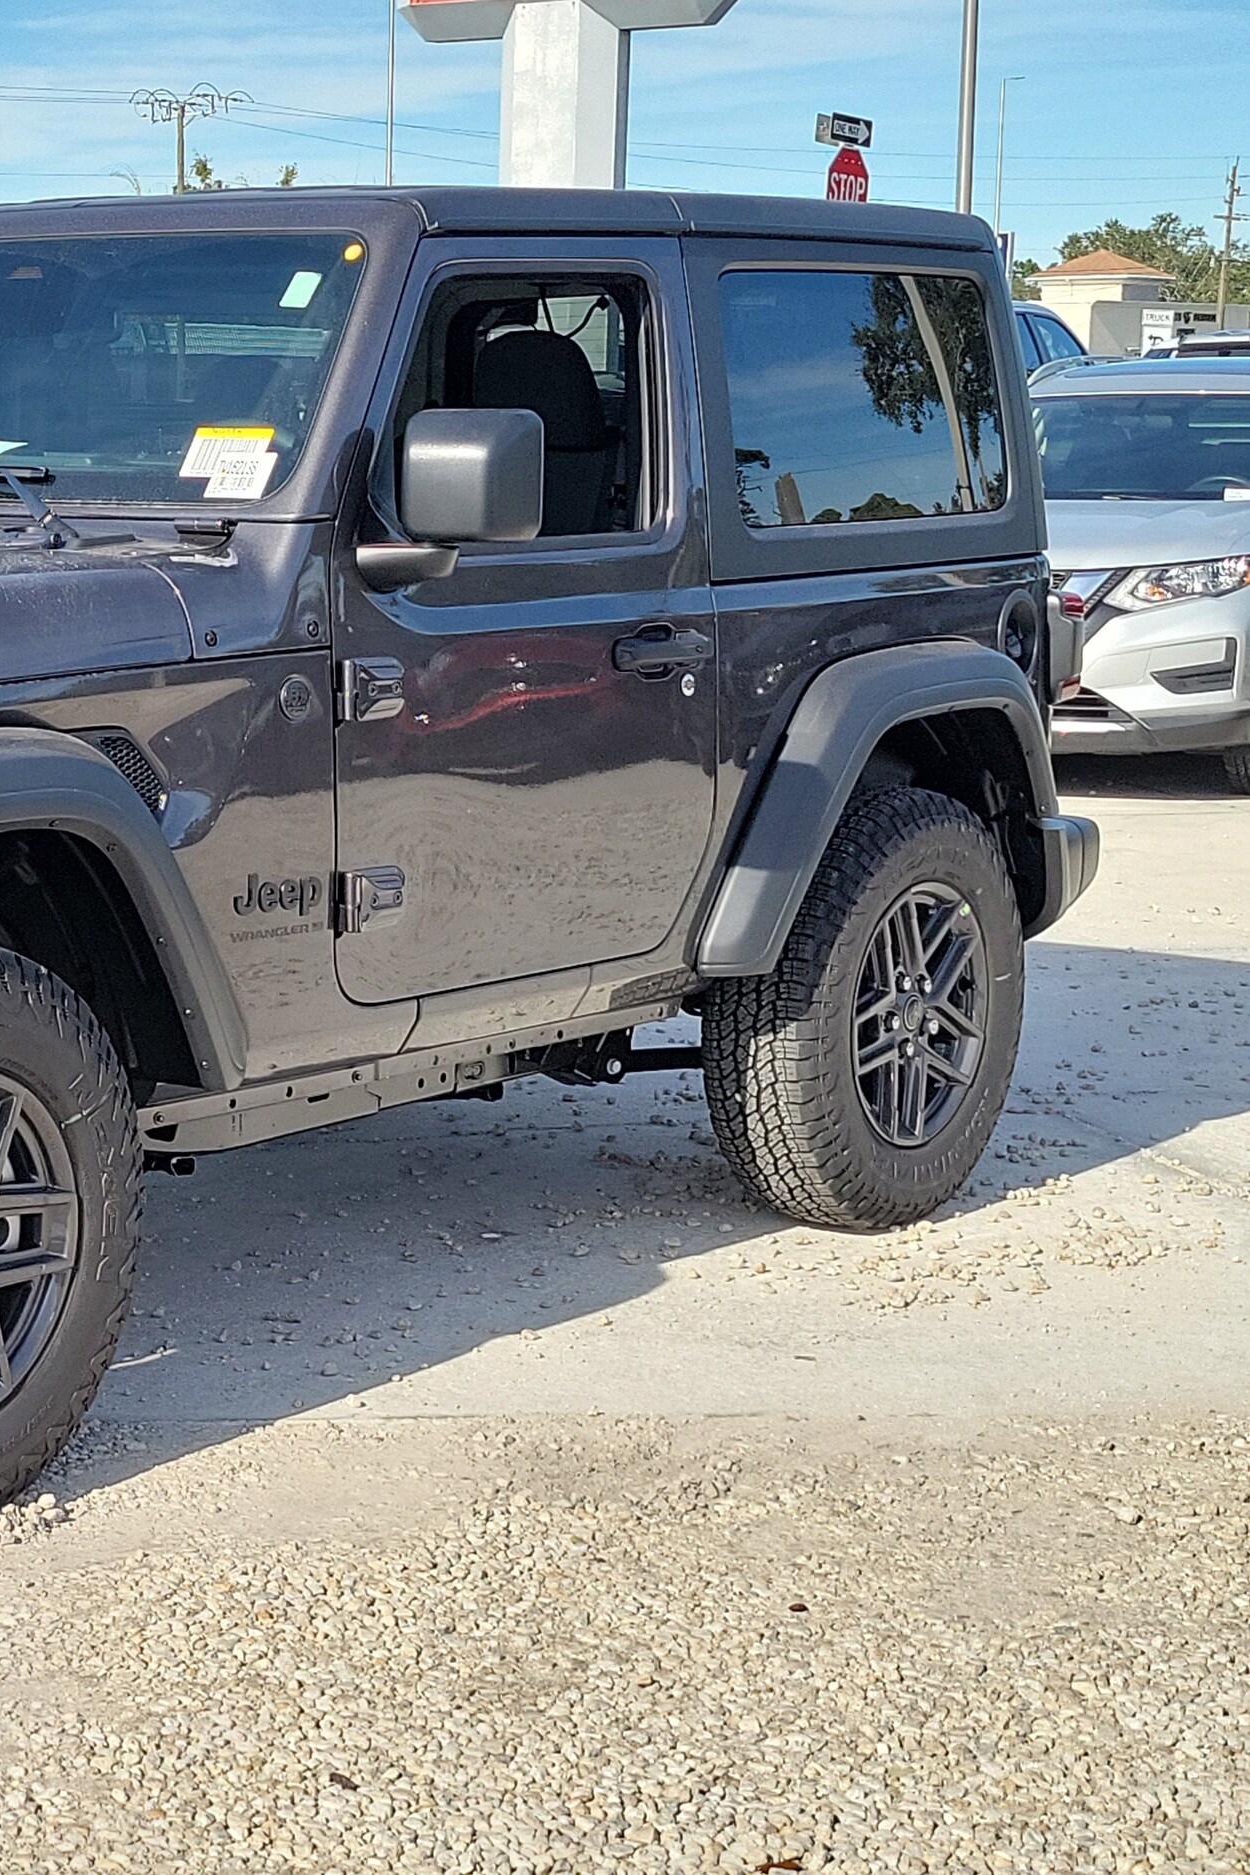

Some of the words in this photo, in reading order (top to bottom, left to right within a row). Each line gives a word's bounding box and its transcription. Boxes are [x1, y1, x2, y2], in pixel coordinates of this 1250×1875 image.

[829, 172, 866, 202] STOP
[1145, 312, 1170, 321] TRUCK
[233, 873, 322, 917] Jeep
[230, 924, 309, 942] WRANGLER
